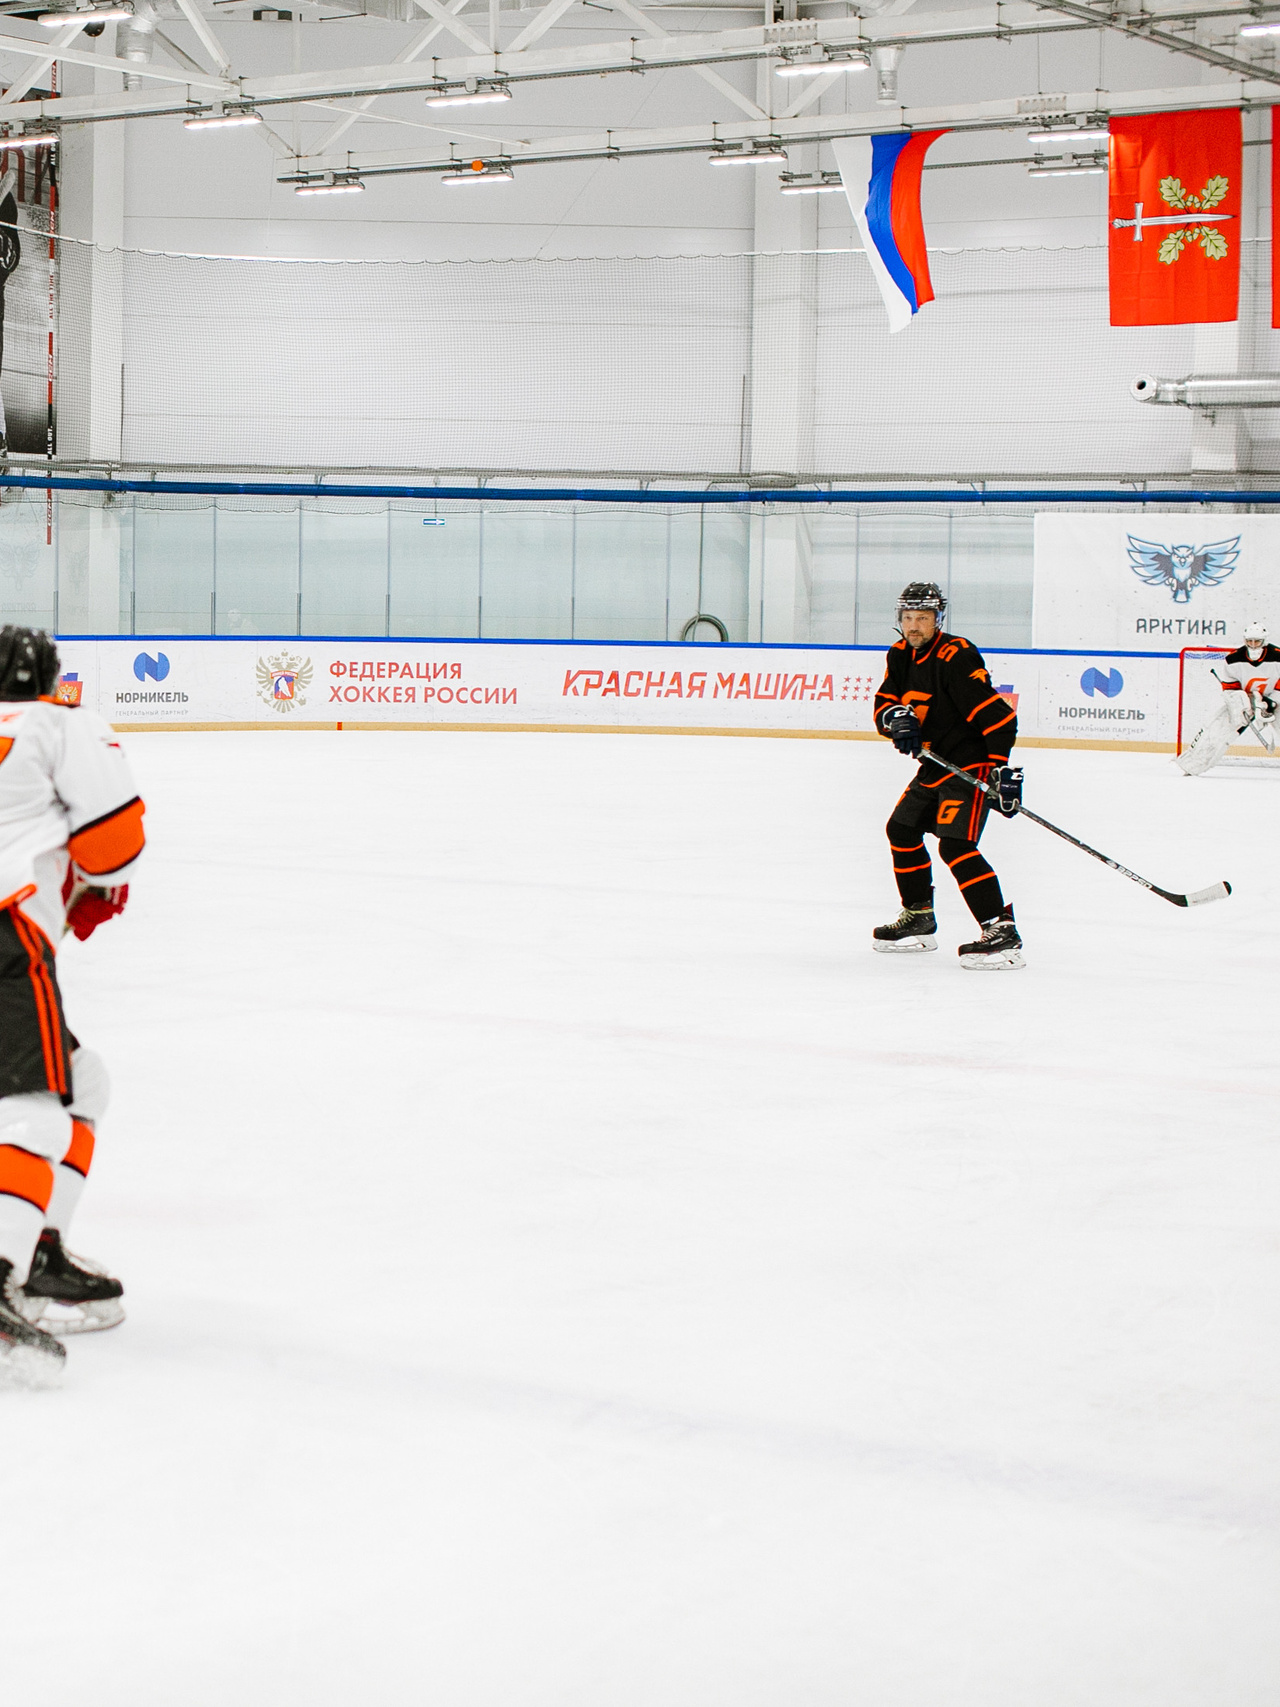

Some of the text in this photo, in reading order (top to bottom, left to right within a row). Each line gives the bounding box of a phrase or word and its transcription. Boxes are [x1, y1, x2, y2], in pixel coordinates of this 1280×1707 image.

[1136, 618, 1226, 635] АРКТИКА
[329, 661, 462, 682] ФЕДЕРАЦИЯ
[562, 669, 834, 701] КРАСНАЯ МАШИНА
[116, 692, 189, 703] НОРНИКЕЛЬ
[329, 686, 517, 704] ХОККЕЯ РОССИИ
[1058, 707, 1145, 720] НОРНИКЕЛЬ
